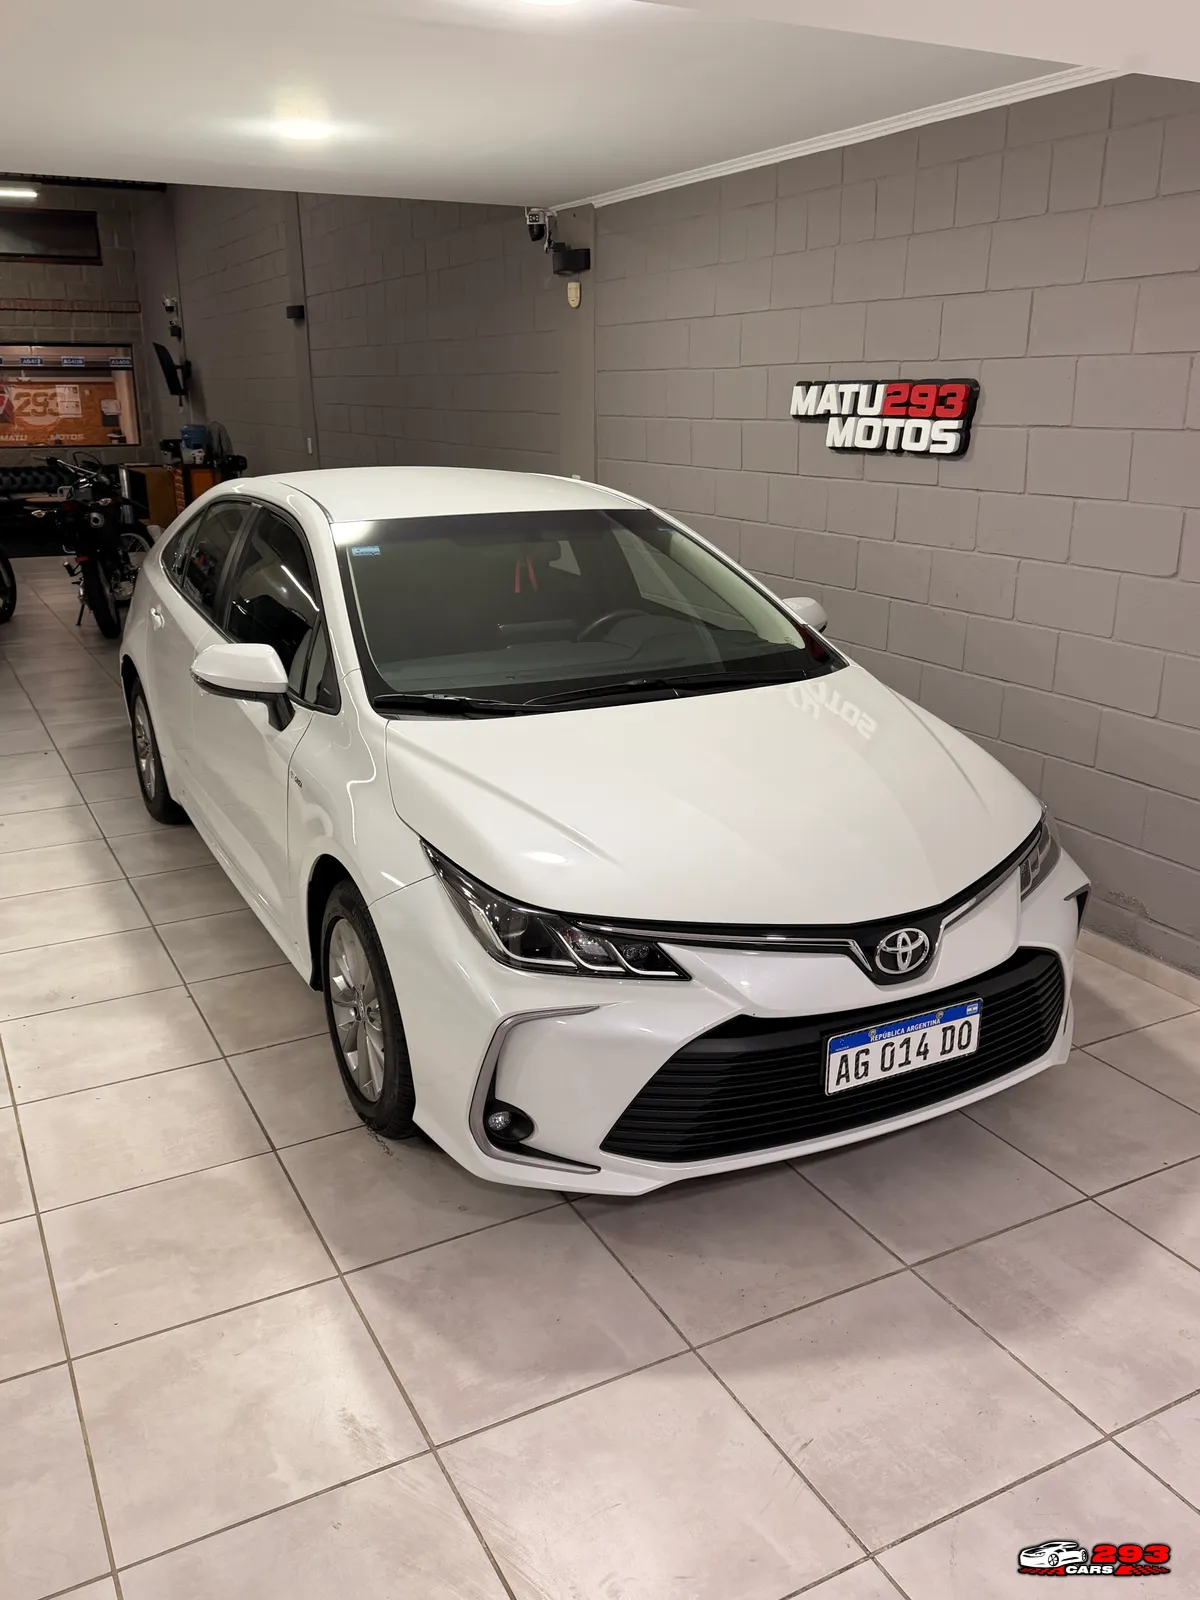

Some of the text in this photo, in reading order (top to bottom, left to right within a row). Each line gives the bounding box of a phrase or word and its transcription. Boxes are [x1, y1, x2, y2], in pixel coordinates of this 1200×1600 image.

[825, 416, 964, 454] MOTOS
[870, 1018, 941, 1042] REPÚBLICA ARGENTINA
[835, 1020, 973, 1086] AG 014 DO
